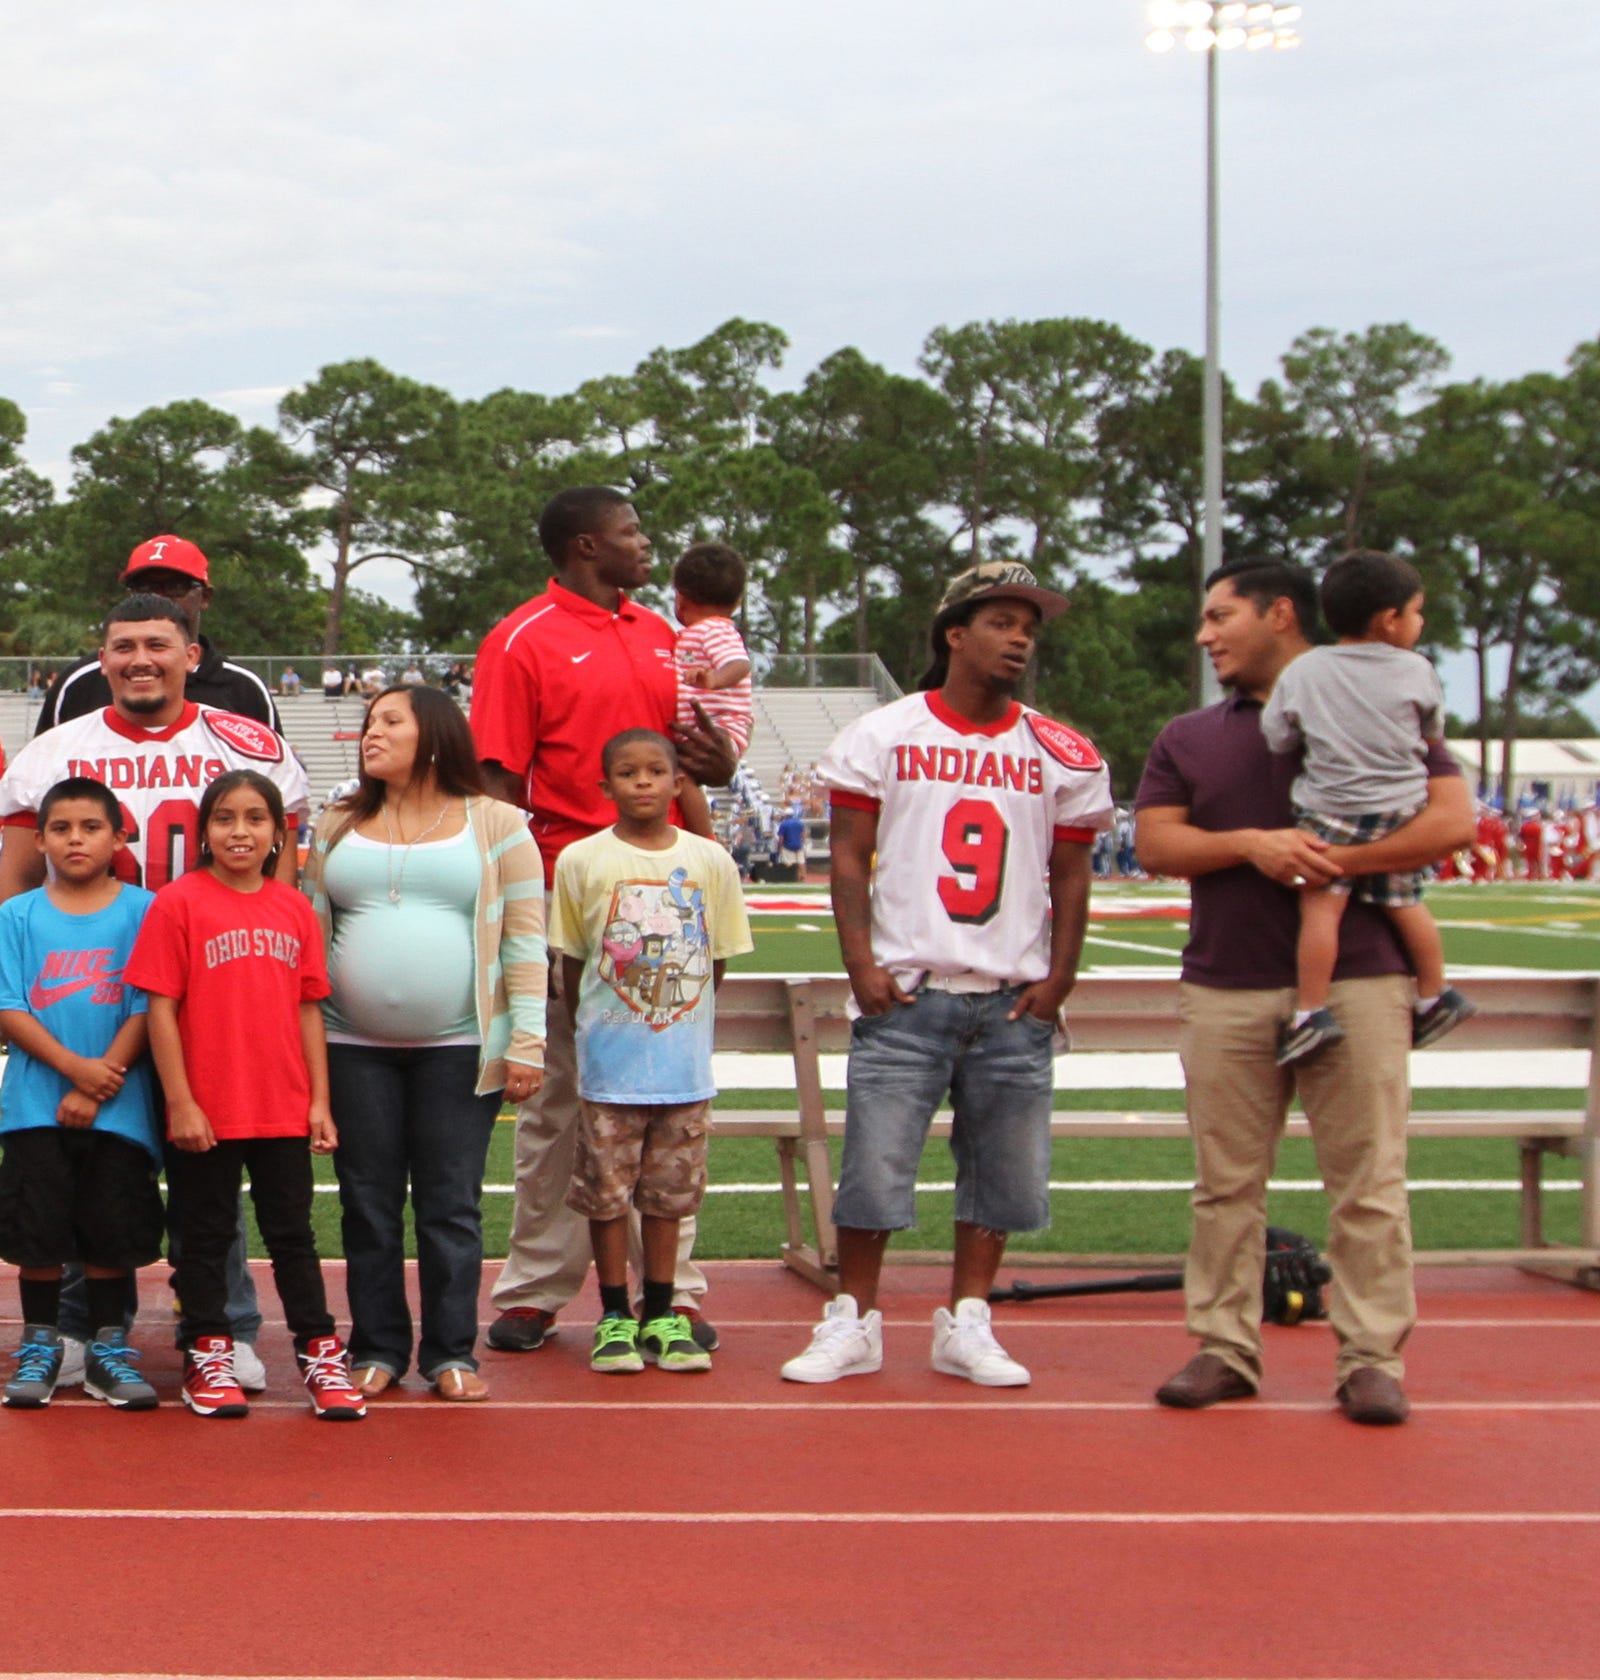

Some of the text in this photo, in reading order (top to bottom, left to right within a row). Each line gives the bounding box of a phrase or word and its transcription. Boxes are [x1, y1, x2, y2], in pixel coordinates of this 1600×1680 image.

[895, 745, 1044, 795] INDIANS
[937, 798, 1011, 926] 9
[40, 948, 115, 979] NIKE
[205, 928, 301, 969] OHIO STATE
